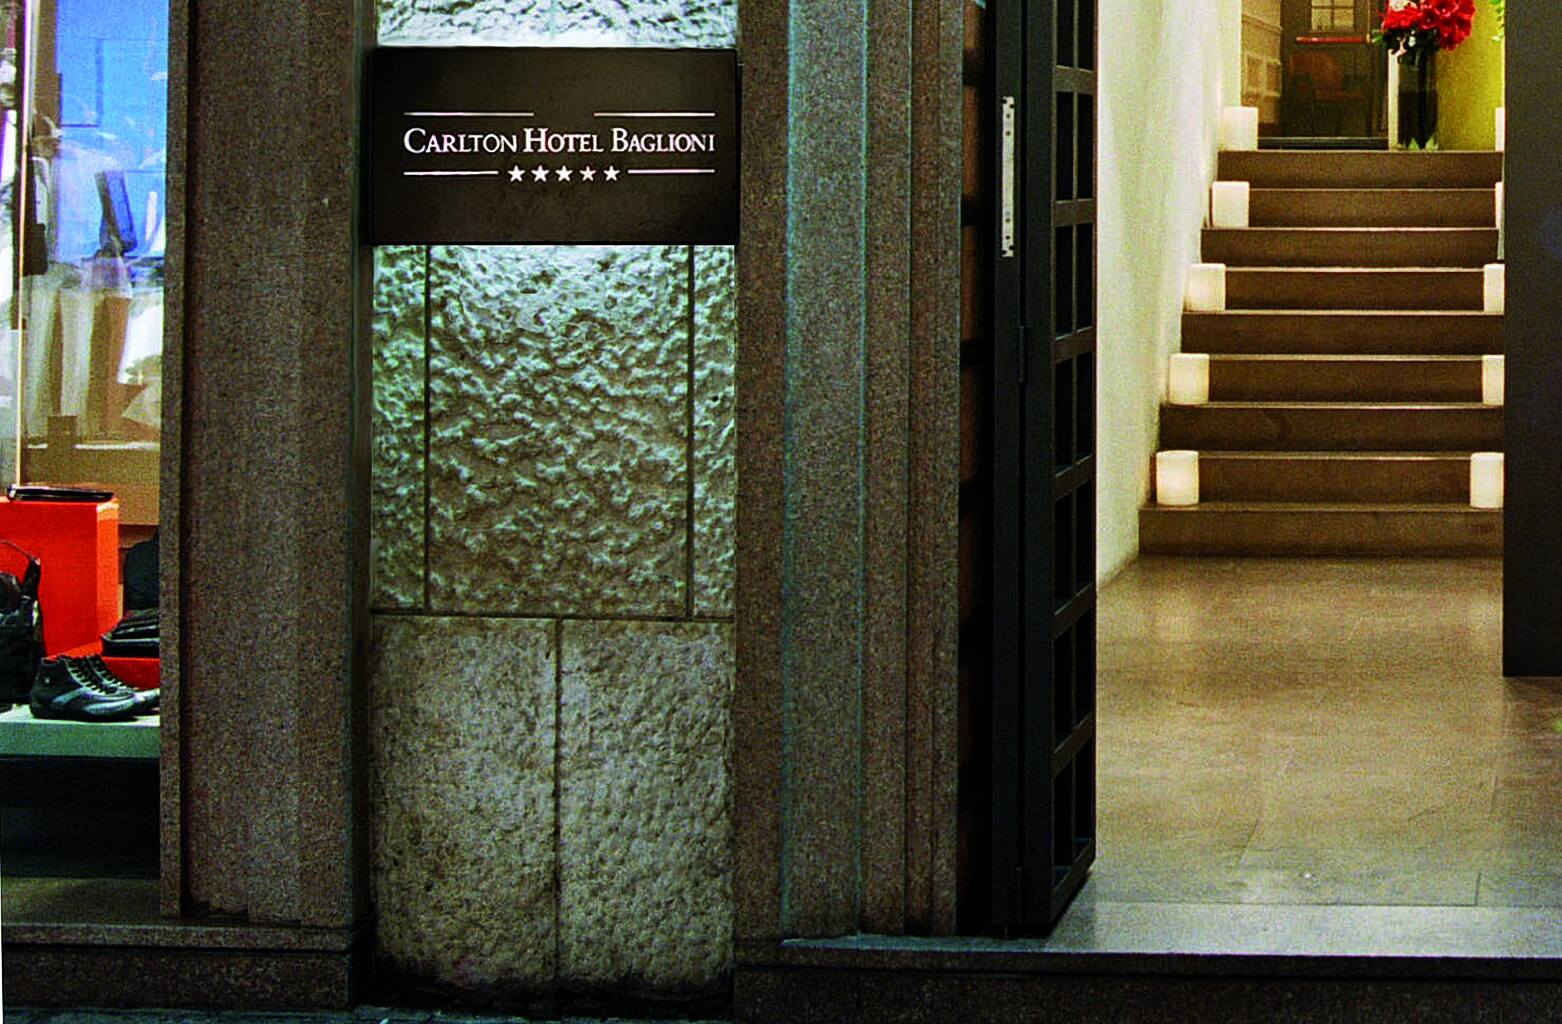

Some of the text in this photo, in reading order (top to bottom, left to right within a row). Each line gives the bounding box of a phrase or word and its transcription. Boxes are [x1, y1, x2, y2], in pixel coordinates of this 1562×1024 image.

[404, 128, 715, 153] CARLTON HOTEL BAGLIONI
